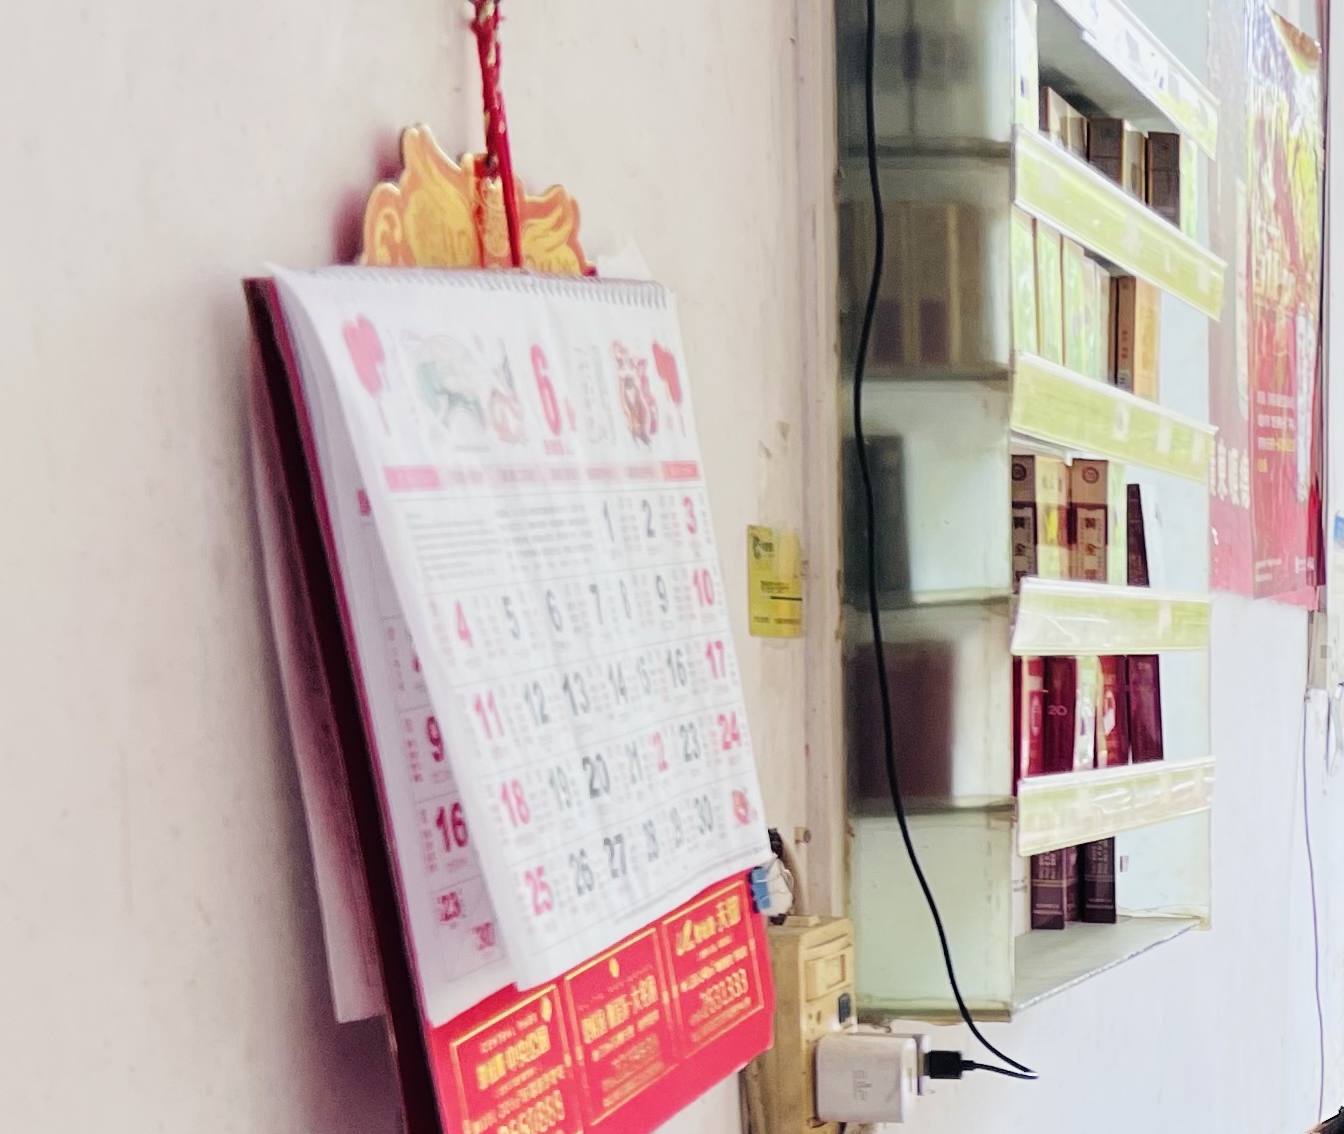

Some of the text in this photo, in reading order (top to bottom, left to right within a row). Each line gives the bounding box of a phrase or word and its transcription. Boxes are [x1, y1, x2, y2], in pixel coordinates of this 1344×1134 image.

[642, 499, 655, 538] 2
[682, 496, 698, 534] 3
[455, 600, 473, 648] 4
[502, 595, 520, 640] 5
[546, 589, 563, 633] 6
[590, 583, 604, 625] 7
[656, 575, 669, 614] 9
[692, 568, 715, 607] 10
[473, 690, 505, 740] 11
[524, 681, 551, 726] 12
[562, 670, 592, 716] 13
[666, 648, 688, 688] 16
[705, 640, 726, 679] 17
[426, 715, 444, 763] 9
[500, 779, 531, 828] 18
[582, 753, 611, 799] 20
[678, 721, 702, 762] 23
[718, 711, 741, 750] 24
[435, 802, 469, 853] 16
[524, 866, 555, 916] 25
[568, 848, 595, 897] 26
[603, 833, 628, 879] 27
